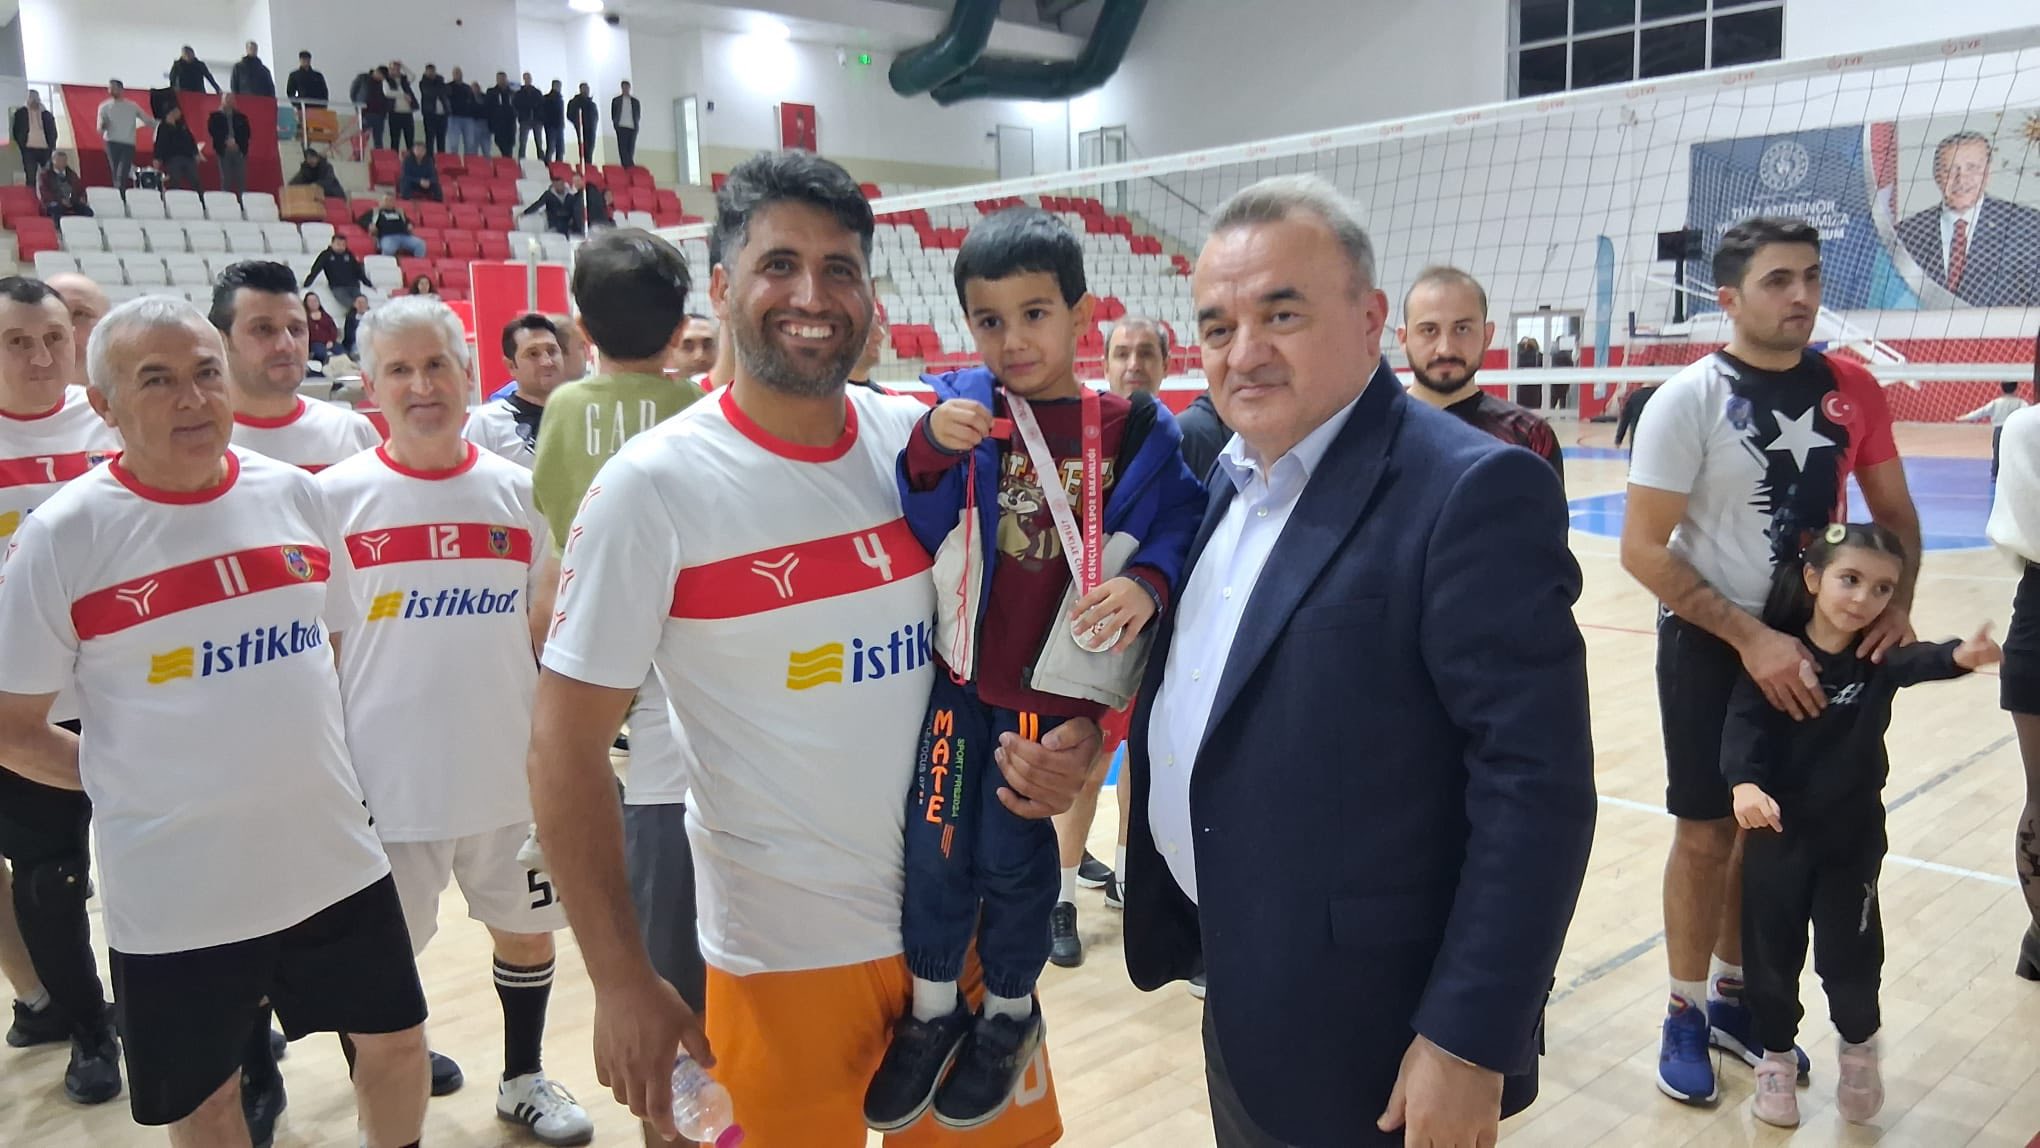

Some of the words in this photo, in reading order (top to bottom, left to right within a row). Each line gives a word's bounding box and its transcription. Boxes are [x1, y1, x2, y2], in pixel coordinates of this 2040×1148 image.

[36, 457, 57, 482] 7
[1088, 499, 1097, 522] SPOR
[1088, 524, 1097, 536] VE
[428, 525, 461, 559] 12
[852, 532, 893, 582] 4
[214, 555, 249, 597] 11
[852, 617, 935, 683] istik
[926, 709, 954, 823] MATE
[527, 868, 560, 910] 5
